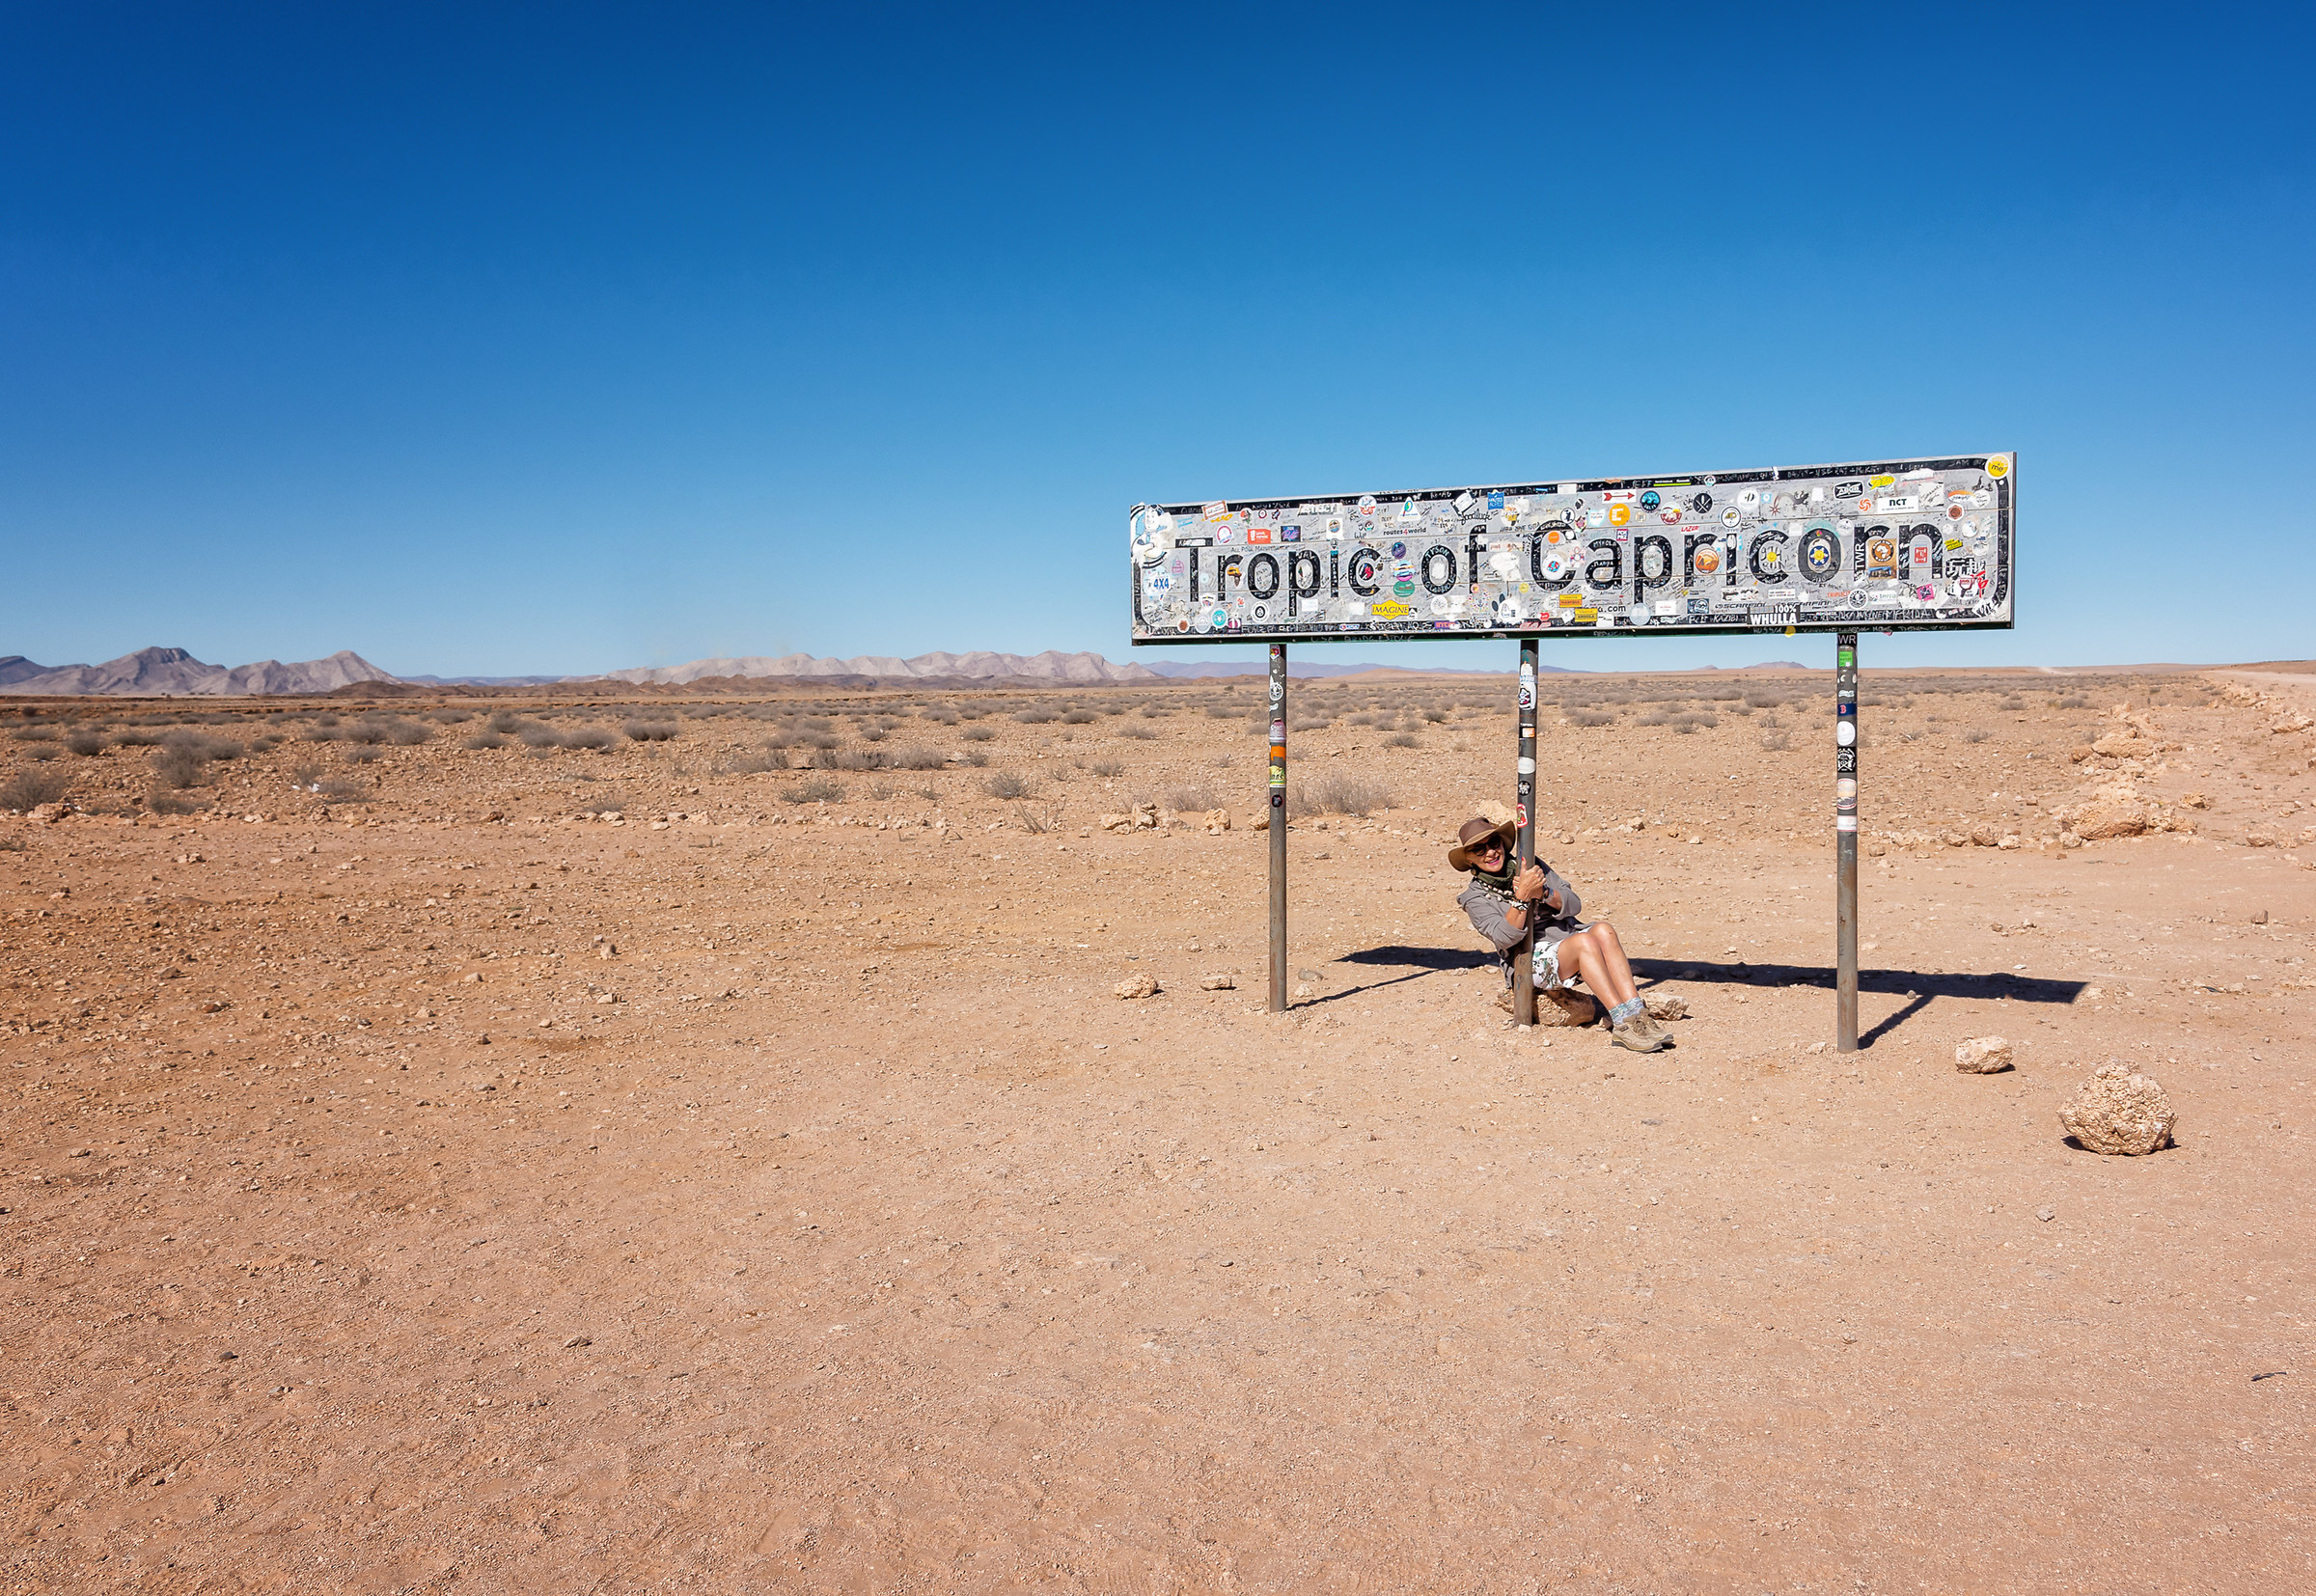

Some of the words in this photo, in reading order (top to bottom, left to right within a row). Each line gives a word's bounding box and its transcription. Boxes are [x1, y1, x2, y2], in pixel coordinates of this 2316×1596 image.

[1383, 527, 1427, 537] routes4world
[1425, 546, 1449, 560] TYSON
[1855, 542, 1865, 570] TWR
[1175, 537, 1381, 618] Tropic
[1421, 524, 1487, 595] of
[1531, 519, 1944, 612] Capricorn
[1372, 606, 1409, 615] IMAGINE
[1774, 604, 1797, 615] 100%
[1750, 613, 1798, 625] WHULLA
[1837, 634, 1857, 645] WR
